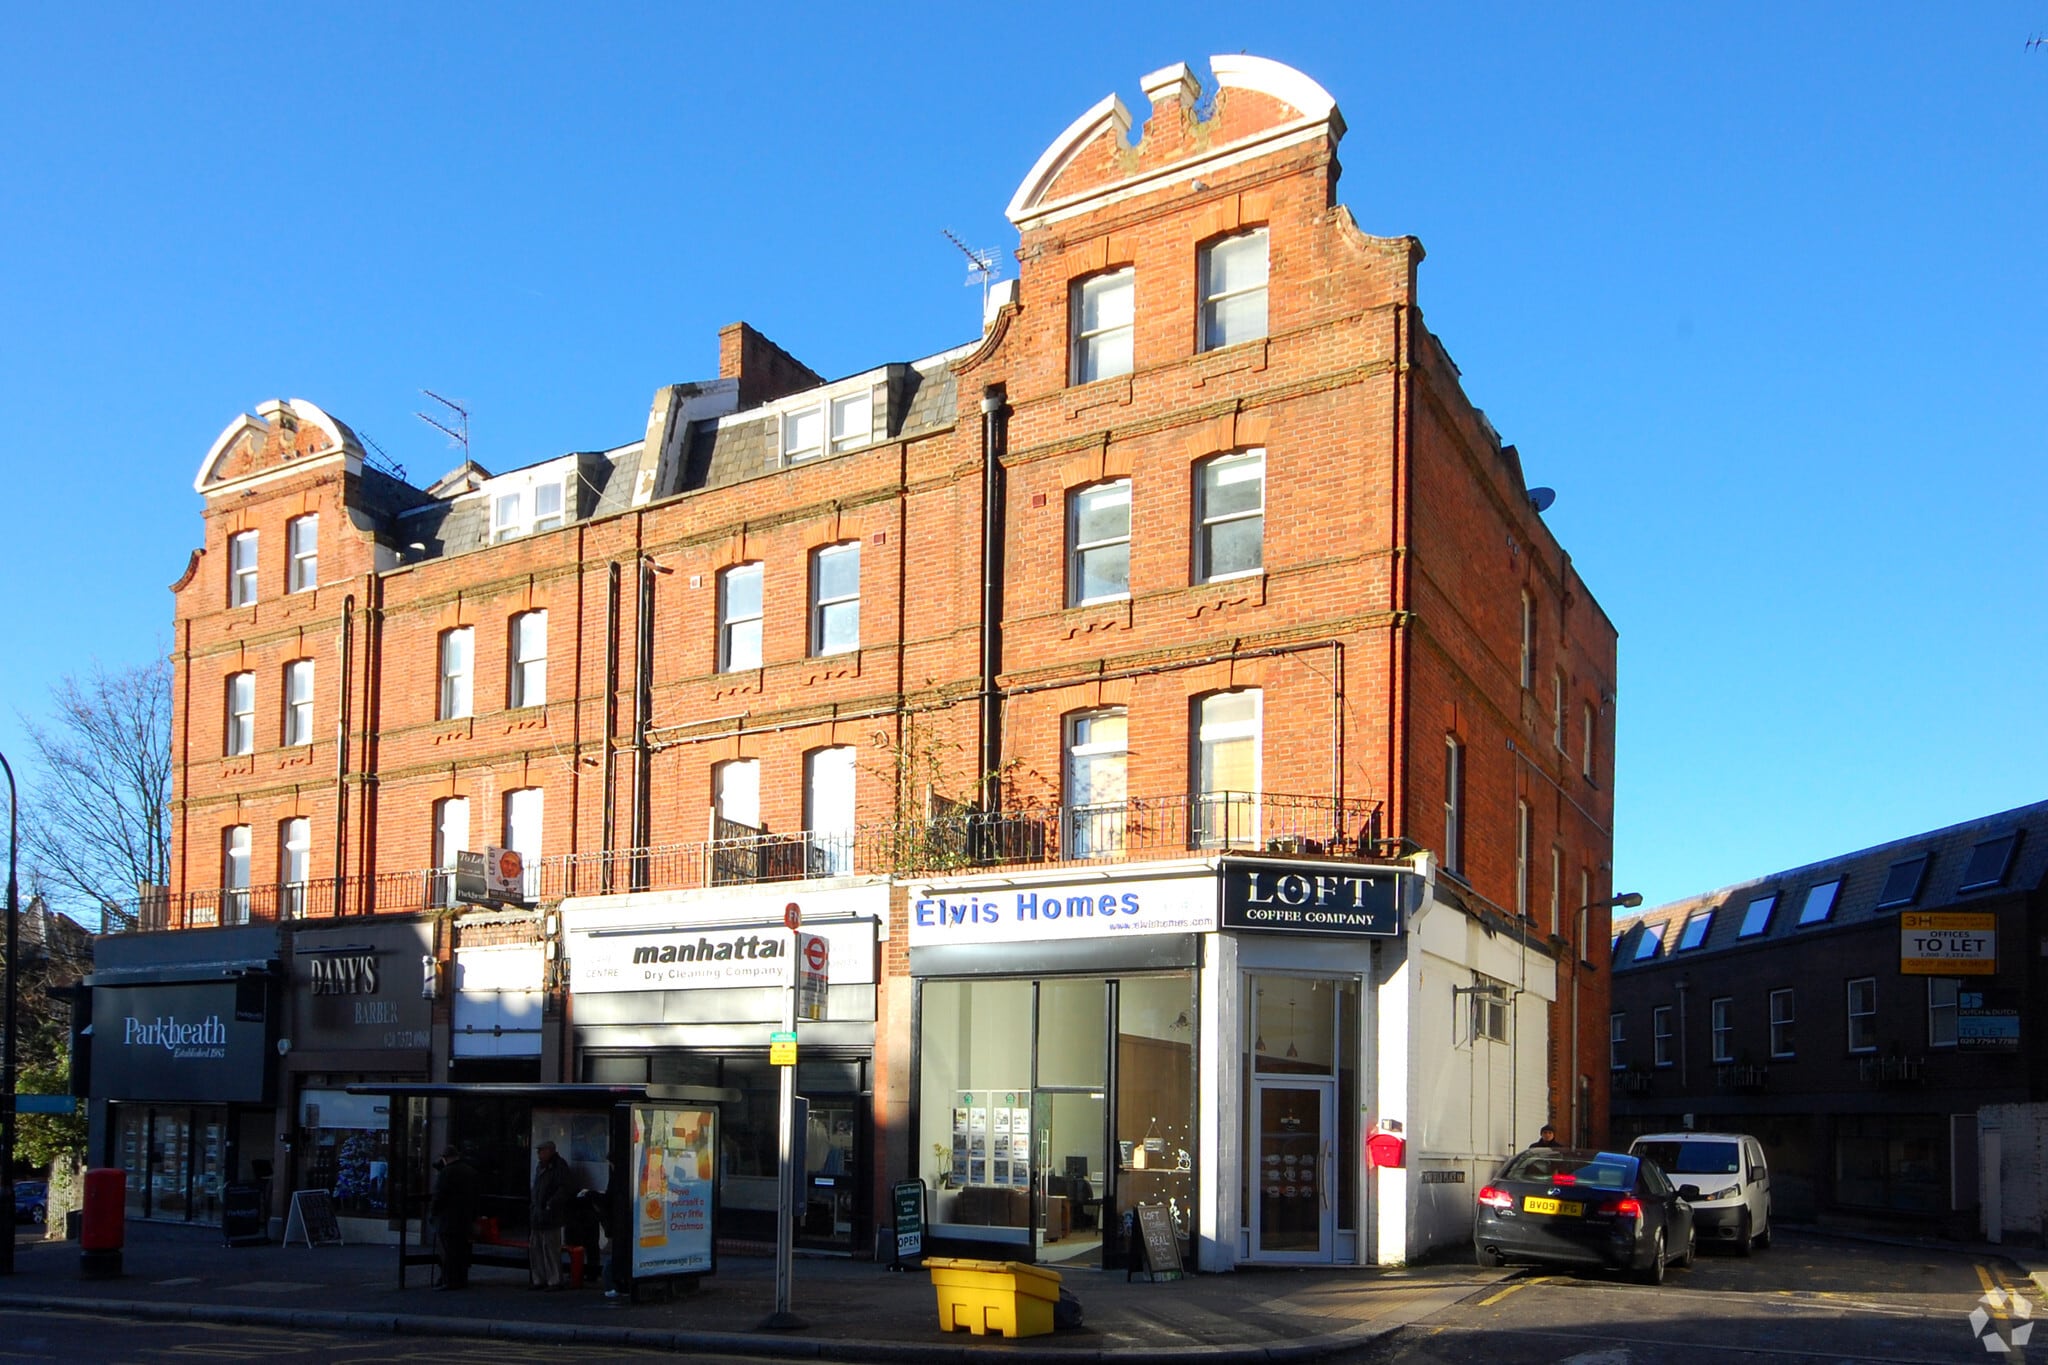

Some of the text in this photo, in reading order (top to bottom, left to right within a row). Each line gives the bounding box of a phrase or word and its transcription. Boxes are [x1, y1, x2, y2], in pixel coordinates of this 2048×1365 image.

[1248, 873, 1374, 908] LOFT
[917, 892, 1141, 928] Elvis Homes
[1246, 909, 1375, 925] COFFEE COMPANY
[1904, 915, 1932, 927] 3H
[1914, 938, 1986, 952] TO LET
[311, 956, 376, 995] DANY'S
[586, 968, 619, 978] CENTRE
[644, 965, 783, 981] Dry Cleaning Company
[354, 1001, 399, 1024] BARBER
[123, 1016, 226, 1050] Parkheath
[1961, 1027, 2004, 1036] TO LET
[174, 1047, 208, 1058] Established
[671, 1197, 698, 1207] yourself
[1529, 1200, 1577, 1213] BV09 YFG
[671, 1211, 686, 1220] juicy
[1143, 1210, 1160, 1220] LOFT
[671, 1222, 704, 1231] Christmas
[898, 1235, 920, 1248] OPEN
